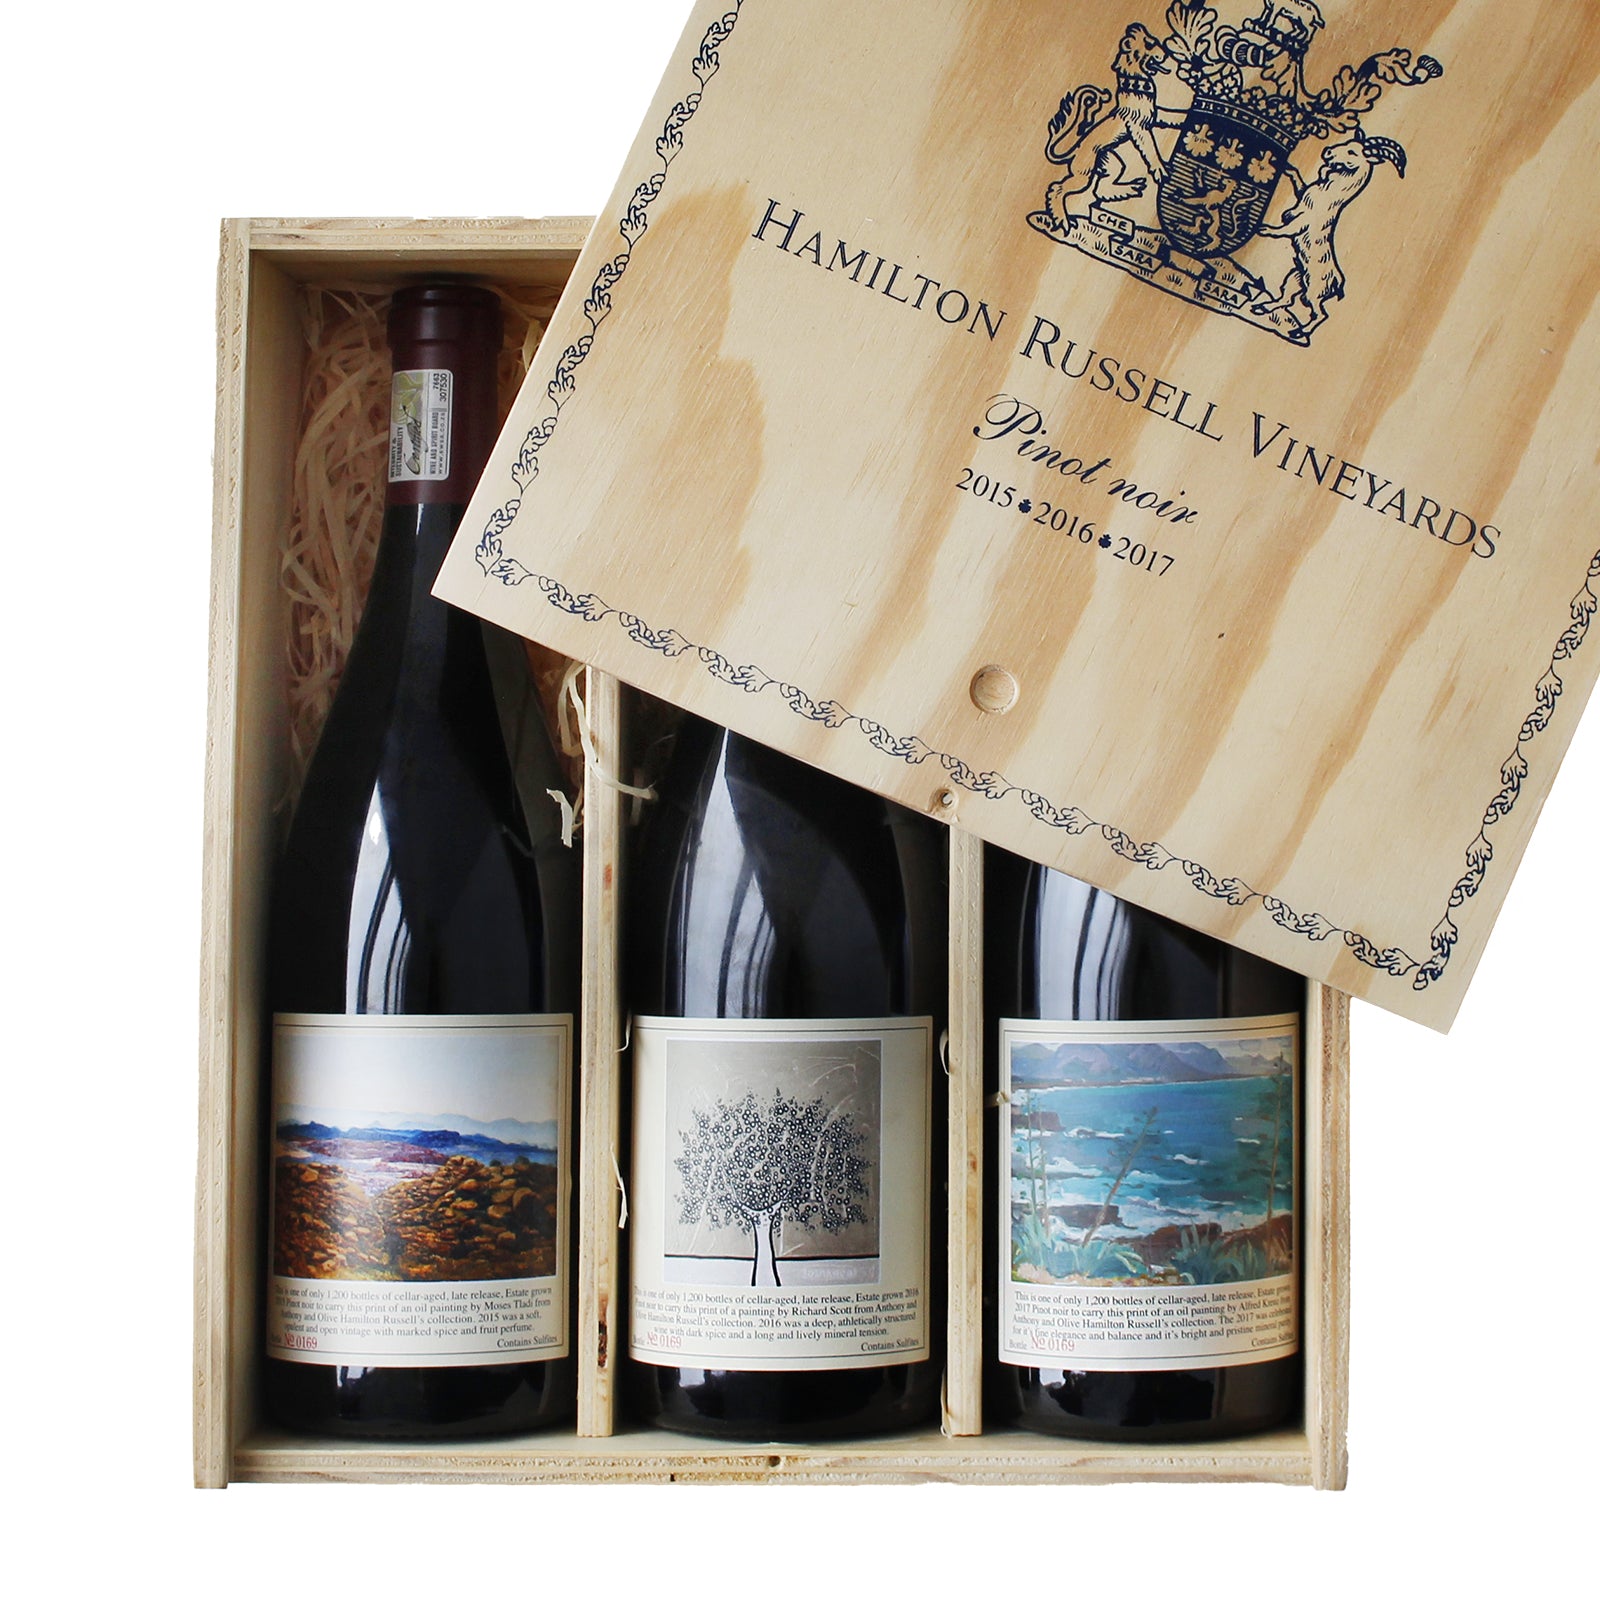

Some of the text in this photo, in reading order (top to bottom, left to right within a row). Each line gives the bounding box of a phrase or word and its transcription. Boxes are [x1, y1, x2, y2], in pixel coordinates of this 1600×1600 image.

[1096, 212, 1128, 231] CHE
[1114, 245, 1153, 268] SARA
[1203, 282, 1239, 305] SARA
[752, 197, 1502, 560] HAMILTON RUSSELL VINEYARDS
[439, 373, 448, 402] 307530
[972, 393, 1199, 526] Pinot noir
[956, 467, 1175, 577] 2015 2016 2017
[309, 1289, 324, 1300] only
[351, 1291, 380, 1300] bottles
[382, 1292, 391, 1300] of
[451, 1291, 468, 1300] late
[505, 1288, 529, 1298] Estate
[705, 1293, 732, 1303] bottles
[735, 1295, 744, 1303] of
[747, 1295, 800, 1306] cellar-aged,
[802, 1295, 818, 1304] late
[856, 1293, 880, 1302] Estate
[1015, 1290, 1029, 1300] This
[1038, 1295, 1051, 1303] one
[1053, 1294, 1062, 1304] of
[1063, 1295, 1082, 1307] only
[1085, 1296, 1110, 1306] 1,200
[1112, 1296, 1143, 1306] bottles
[1145, 1296, 1156, 1305] of
[1158, 1294, 1210, 1305] cellar-aged,
[1212, 1293, 1226, 1302] late
[325, 1304, 345, 1313] carry
[347, 1303, 362, 1311] this
[365, 1304, 386, 1314] print
[389, 1304, 399, 1312] of
[415, 1304, 427, 1312] oil
[430, 1303, 468, 1314] painting
[470, 1303, 481, 1313] by
[484, 1302, 512, 1310] Moses
[513, 1299, 533, 1309] Tladi
[664, 1304, 681, 1314] carry
[683, 1303, 697, 1313] this
[699, 1305, 718, 1316] print
[719, 1305, 729, 1315] of
[738, 1307, 775, 1317] painting
[778, 1307, 789, 1317] by
[792, 1306, 827, 1316] Richard
[830, 1305, 852, 1315] Scott
[854, 1304, 874, 1314] from
[875, 1303, 905, 1312] Anthony
[1032, 1304, 1051, 1314] Pinot
[1053, 1307, 1069, 1316] noir
[1071, 1308, 1080, 1316] to
[1082, 1309, 1104, 1319] carry
[1107, 1308, 1124, 1317] this
[1126, 1308, 1148, 1319] print
[1151, 1307, 1162, 1317] of
[1176, 1307, 1188, 1316] oil
[1191, 1305, 1225, 1317] painting
[1227, 1303, 1237, 1313] by
[317, 1313, 338, 1323] Olive
[340, 1314, 381, 1324] Hamilton
[383, 1314, 425, 1324] Russell's
[427, 1314, 476, 1324] collection.
[478, 1312, 499, 1323] 2015
[676, 1315, 709, 1326] Russell's
[711, 1317, 756, 1327] collection.
[759, 1318, 781, 1327] 2016
[812, 1318, 836, 1329] deep,
[838, 1315, 882, 1326] athletically
[1042, 1317, 1055, 1326] and
[1057, 1318, 1080, 1328] Olive
[1082, 1319, 1124, 1329] Hamilton
[1127, 1319, 1168, 1329] Russell's
[1171, 1317, 1217, 1327] collection.
[1220, 1315, 1234, 1324] The
[1236, 1312, 1254, 1323] 2017
[306, 1325, 318, 1333] and
[320, 1327, 338, 1336] open
[340, 1326, 371, 1337] vintage
[373, 1326, 394, 1336] with
[396, 1326, 431, 1336] marked
[434, 1327, 458, 1338] spice
[461, 1325, 477, 1335] and
[479, 1324, 499, 1334] fruit
[669, 1327, 684, 1336] with
[686, 1328, 702, 1337] dark
[706, 1329, 726, 1339] spice
[729, 1330, 744, 1339] and
[754, 1331, 774, 1341] long
[777, 1331, 793, 1339] and
[796, 1330, 821, 1340] lively
[824, 1328, 857, 1338] mineral
[1051, 1329, 1086, 1340] elegance
[1089, 1331, 1105, 1340] and
[1108, 1330, 1143, 1340] balance
[1145, 1331, 1162, 1340] and
[1165, 1330, 1179, 1339] it's
[1181, 1329, 1207, 1340] bright
[1209, 1328, 1224, 1337] and
[1226, 1326, 1254, 1337] pristine
[296, 1335, 318, 1350] 0169
[496, 1337, 532, 1348] Contains
[660, 1335, 682, 1349] 0169
[861, 1341, 895, 1351] Contains
[1048, 1339, 1075, 1351] 0169
